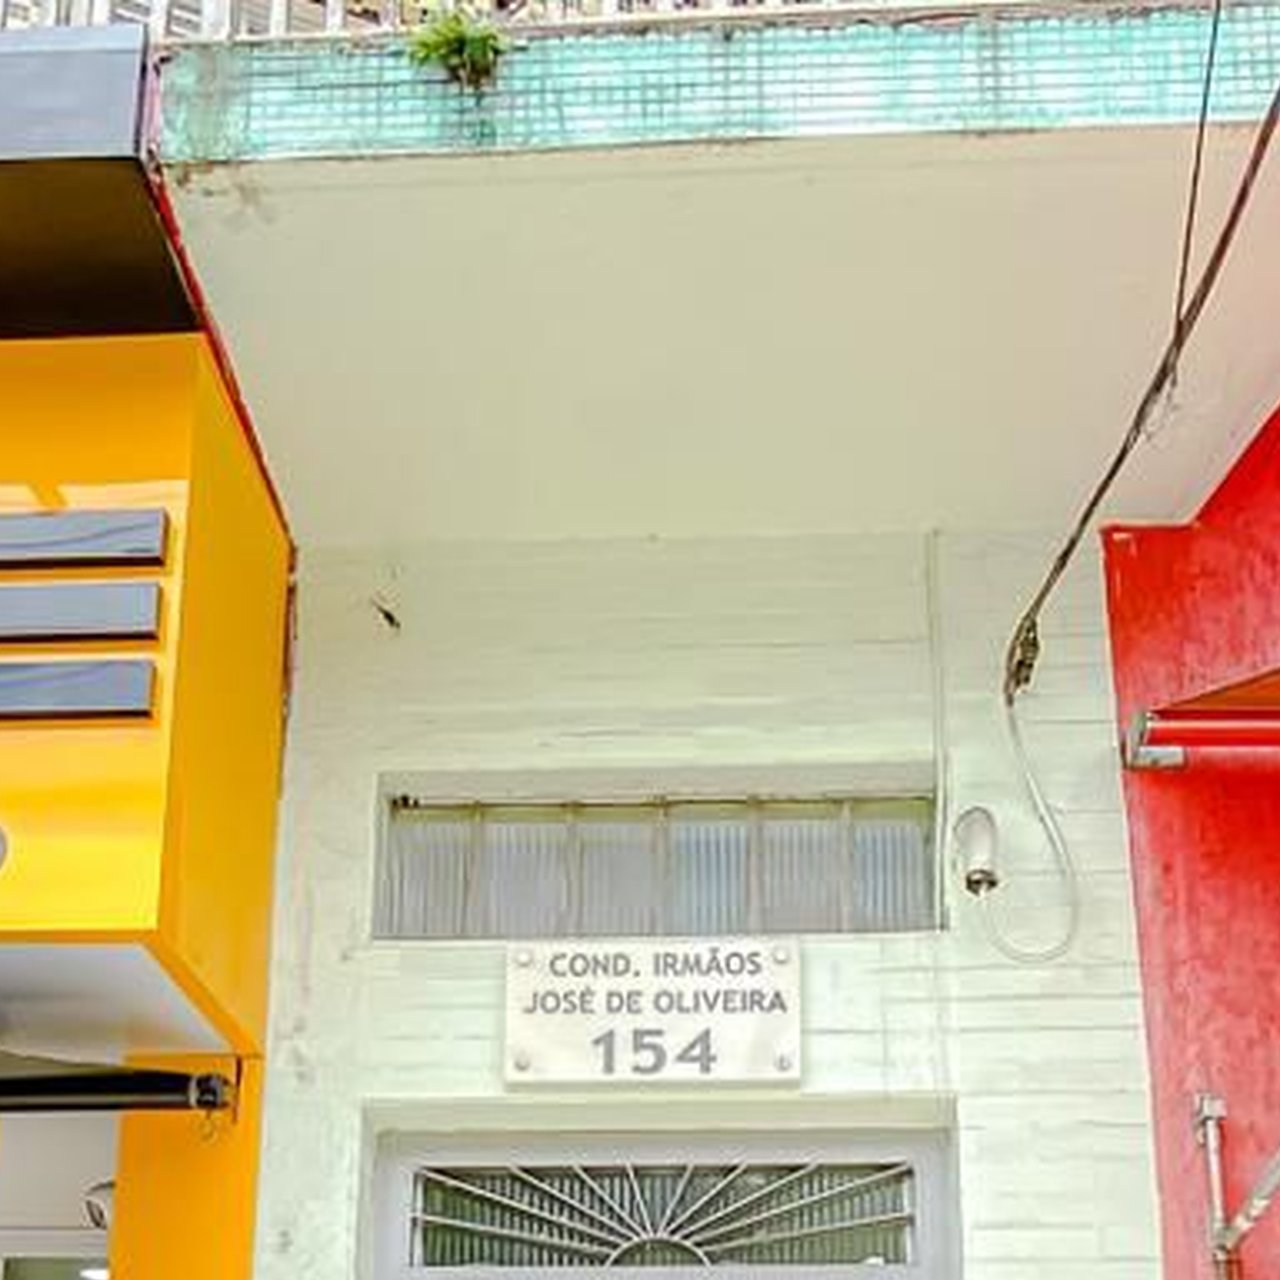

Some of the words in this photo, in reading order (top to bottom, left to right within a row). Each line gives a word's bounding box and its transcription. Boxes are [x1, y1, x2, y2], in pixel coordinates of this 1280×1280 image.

[548, 950, 642, 979] COND.
[652, 945, 764, 978] IRMÃOS
[522, 985, 597, 1016] JOSÉ
[605, 991, 642, 1015] DE
[652, 990, 789, 1015] OLIVEIRA
[589, 1028, 719, 1076] 154
